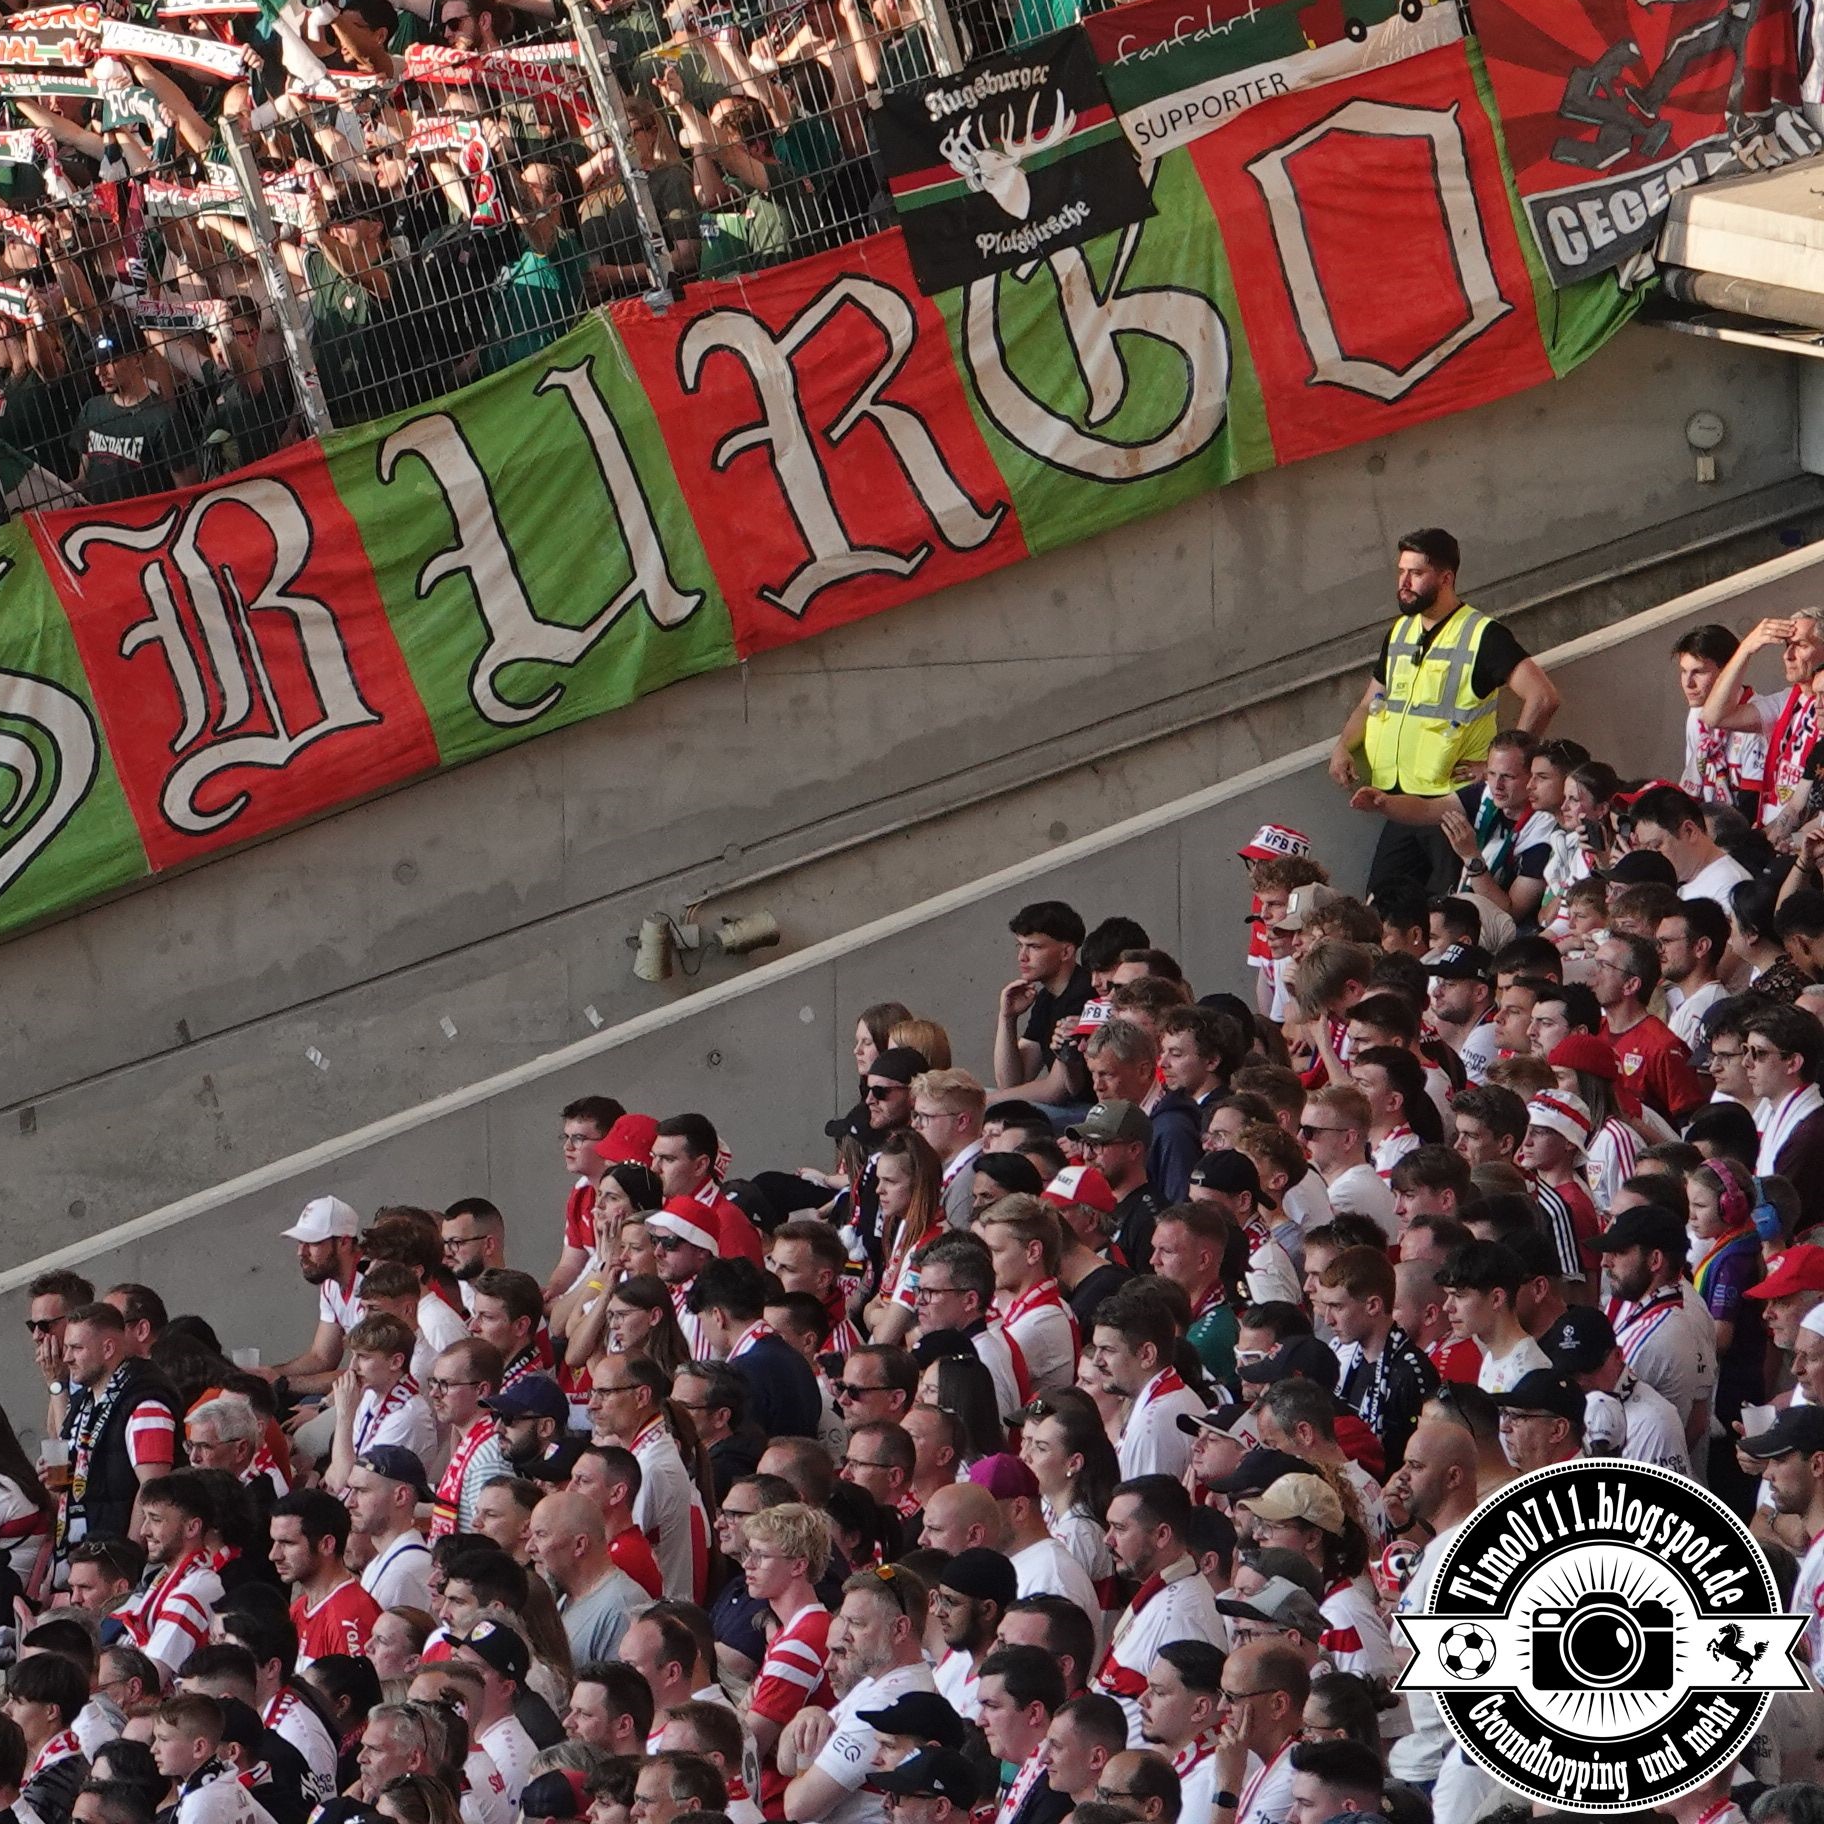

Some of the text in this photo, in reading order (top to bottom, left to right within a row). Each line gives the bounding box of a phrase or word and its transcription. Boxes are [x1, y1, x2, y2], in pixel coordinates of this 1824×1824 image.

[1115, 1, 1263, 71] fanfahrt
[926, 62, 1052, 119] Augsburger
[1131, 69, 1293, 147] SUPPORTER
[974, 196, 1094, 260] Platzhirsche
